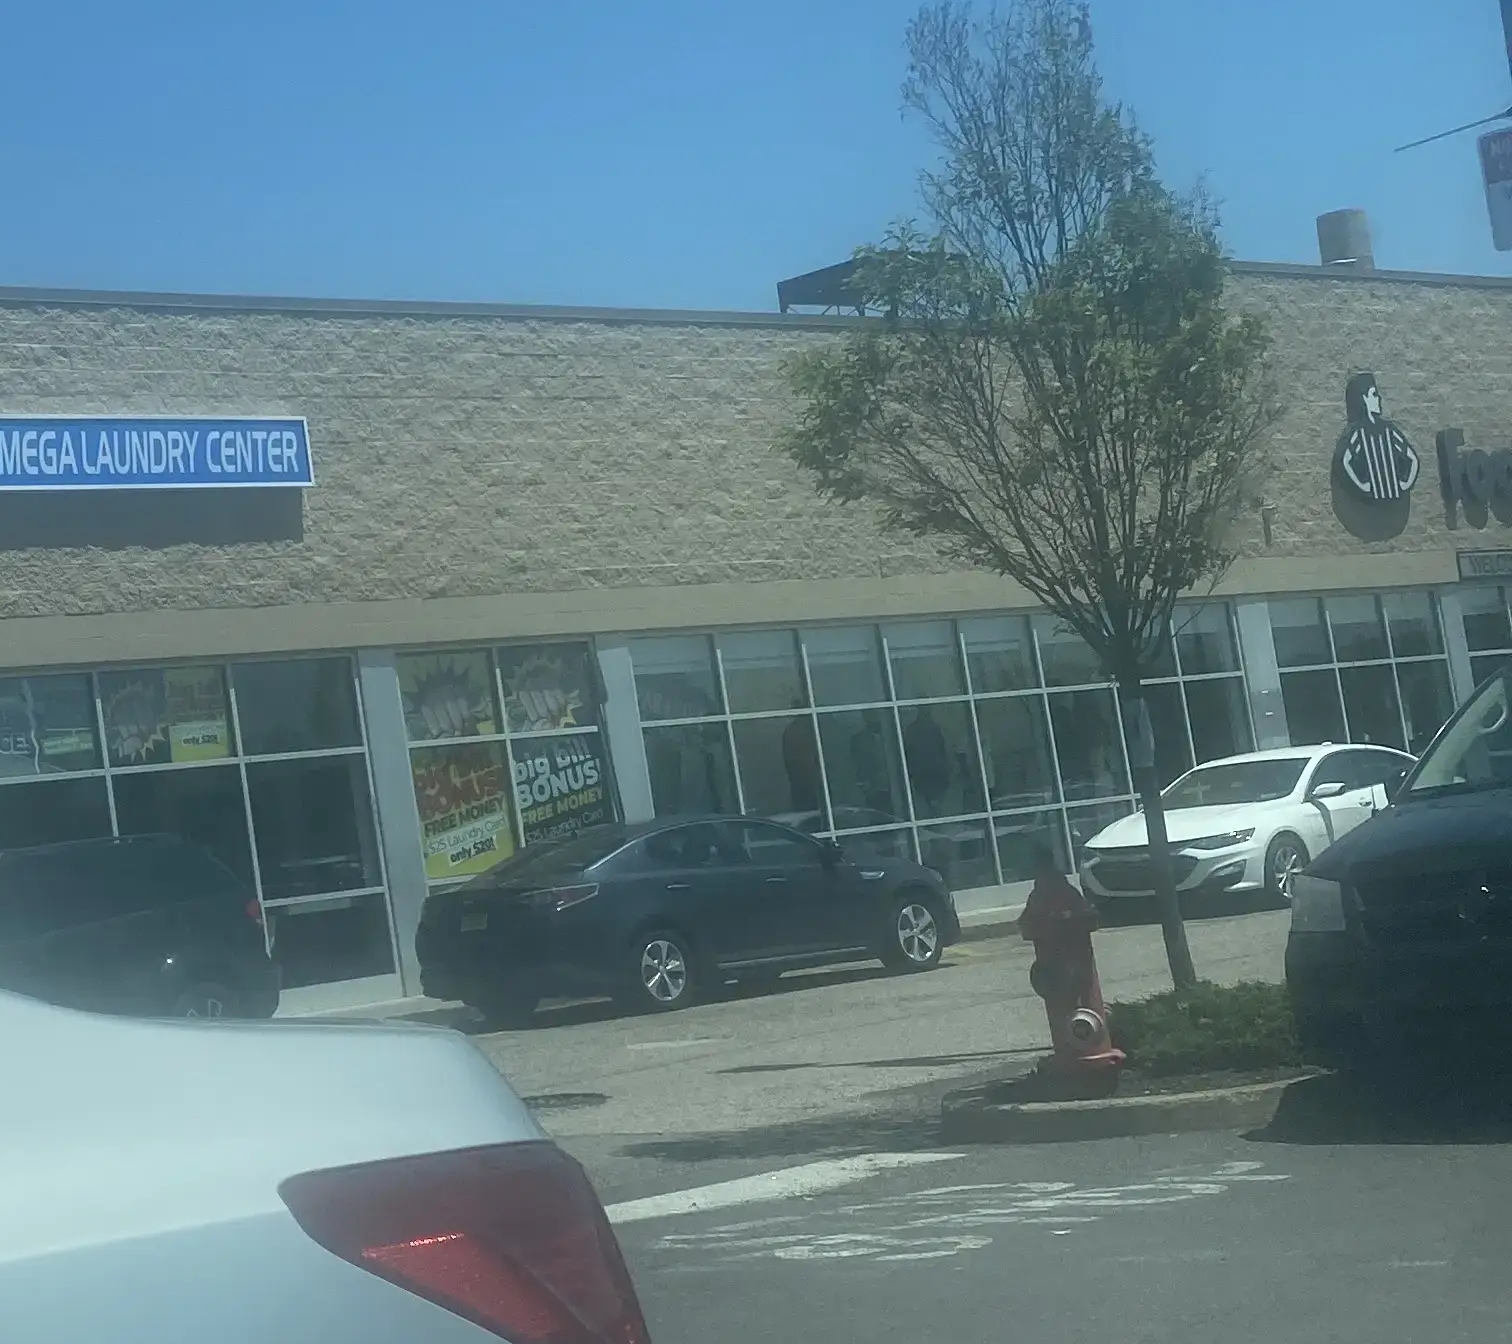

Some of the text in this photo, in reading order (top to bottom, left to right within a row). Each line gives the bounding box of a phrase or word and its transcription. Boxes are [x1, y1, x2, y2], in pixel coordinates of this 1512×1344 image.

[81, 430, 200, 475] LAUNDRY
[204, 430, 299, 474] CENTER
[521, 786, 603, 825] FREE MONEY
[424, 814, 457, 838] FREE
[448, 826, 484, 848] Laundry
[450, 837, 495, 863] only $20!
